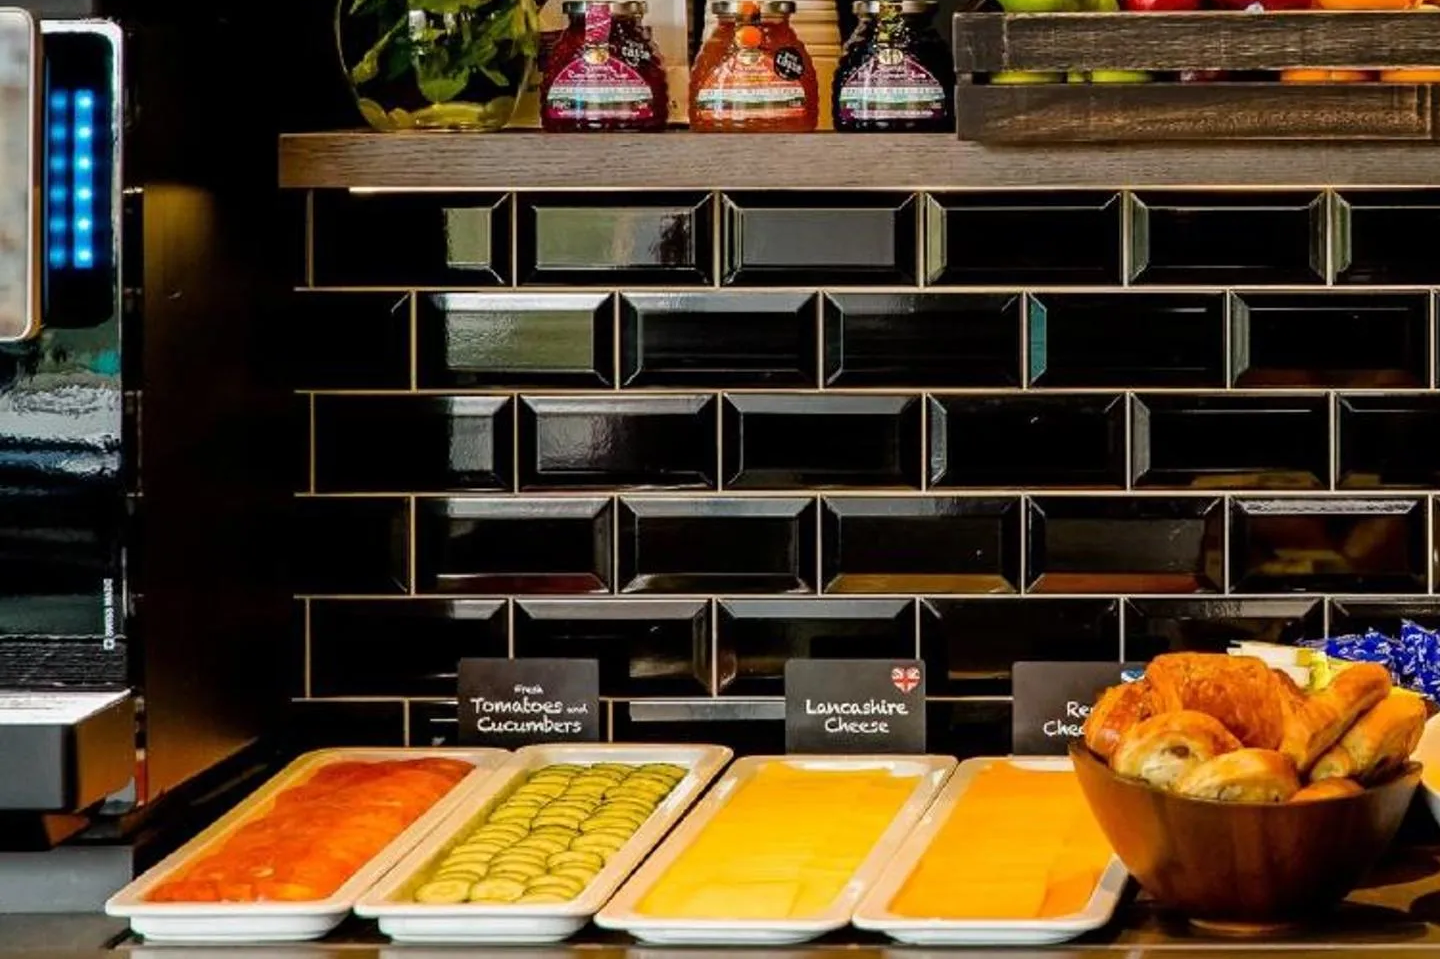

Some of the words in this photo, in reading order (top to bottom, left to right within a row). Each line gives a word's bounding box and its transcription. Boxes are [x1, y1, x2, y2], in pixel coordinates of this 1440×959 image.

[470, 696, 563, 713] Tomatoes
[805, 699, 909, 714] Lancashire
[477, 715, 582, 733] Cucumbers
[825, 718, 890, 733] Cheese
